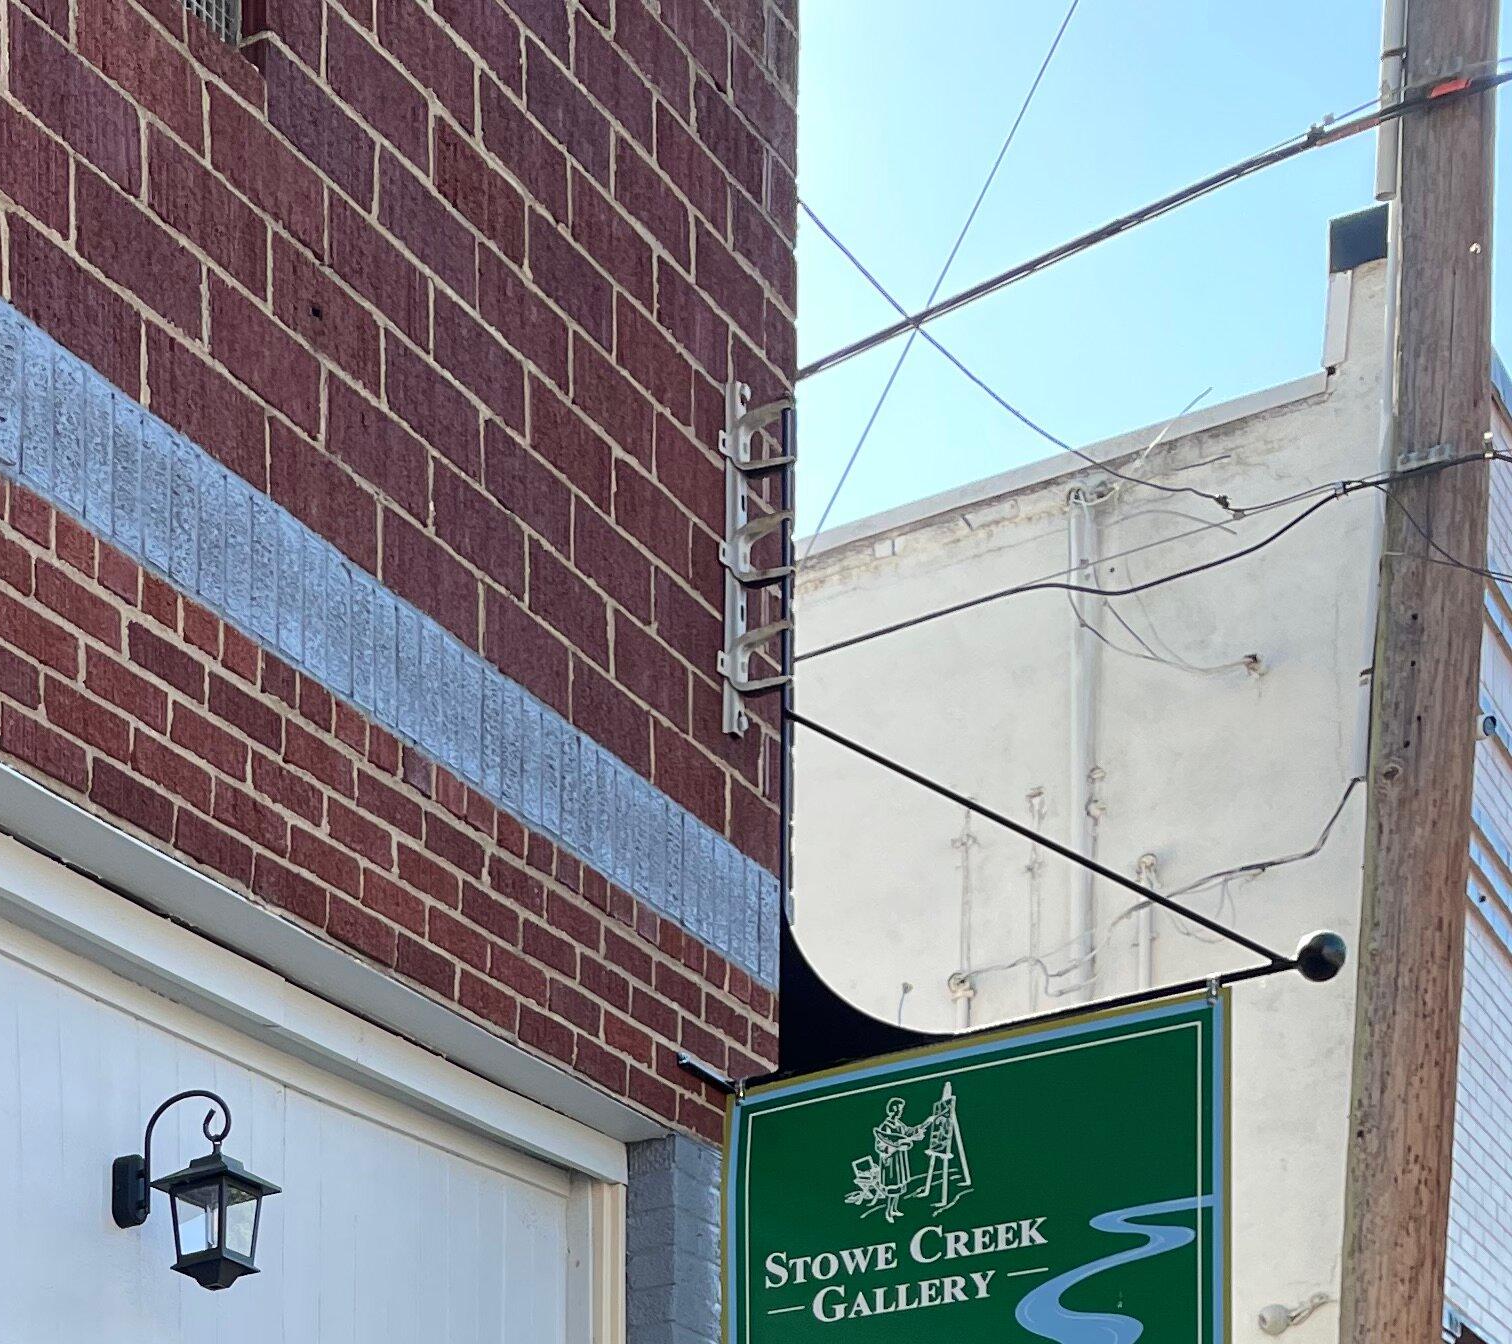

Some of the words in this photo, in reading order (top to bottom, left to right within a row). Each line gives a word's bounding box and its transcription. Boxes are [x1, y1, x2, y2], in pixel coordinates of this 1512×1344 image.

[764, 1242, 898, 1289] STOWE
[909, 1216, 1049, 1264] CREEK
[812, 1270, 996, 1323] GALLERY
